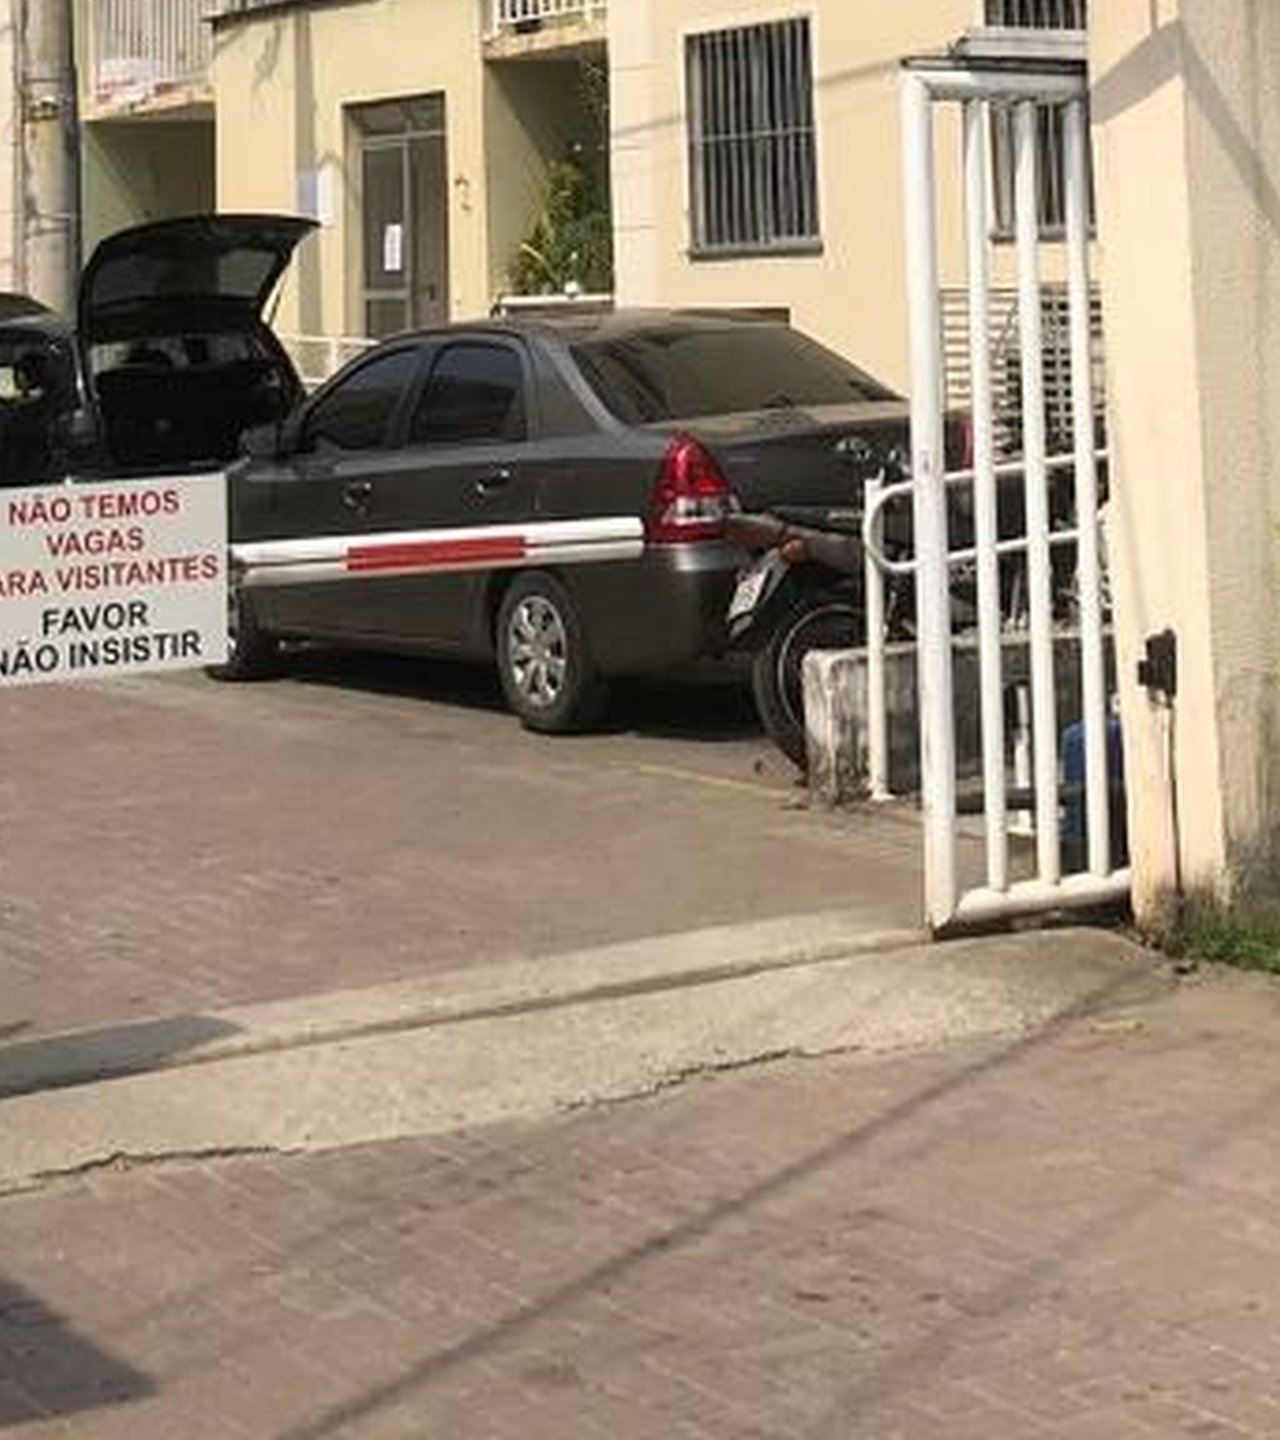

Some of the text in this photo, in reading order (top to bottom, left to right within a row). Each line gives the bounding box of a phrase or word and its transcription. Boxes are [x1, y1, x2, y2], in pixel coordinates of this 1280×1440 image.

[8, 490, 180, 525] NÃO TEMOS
[46, 527, 144, 556] VAGAS
[56, 554, 218, 592] VISITANTES
[42, 600, 149, 636] FAVOR
[70, 630, 202, 669] INSISTIR
